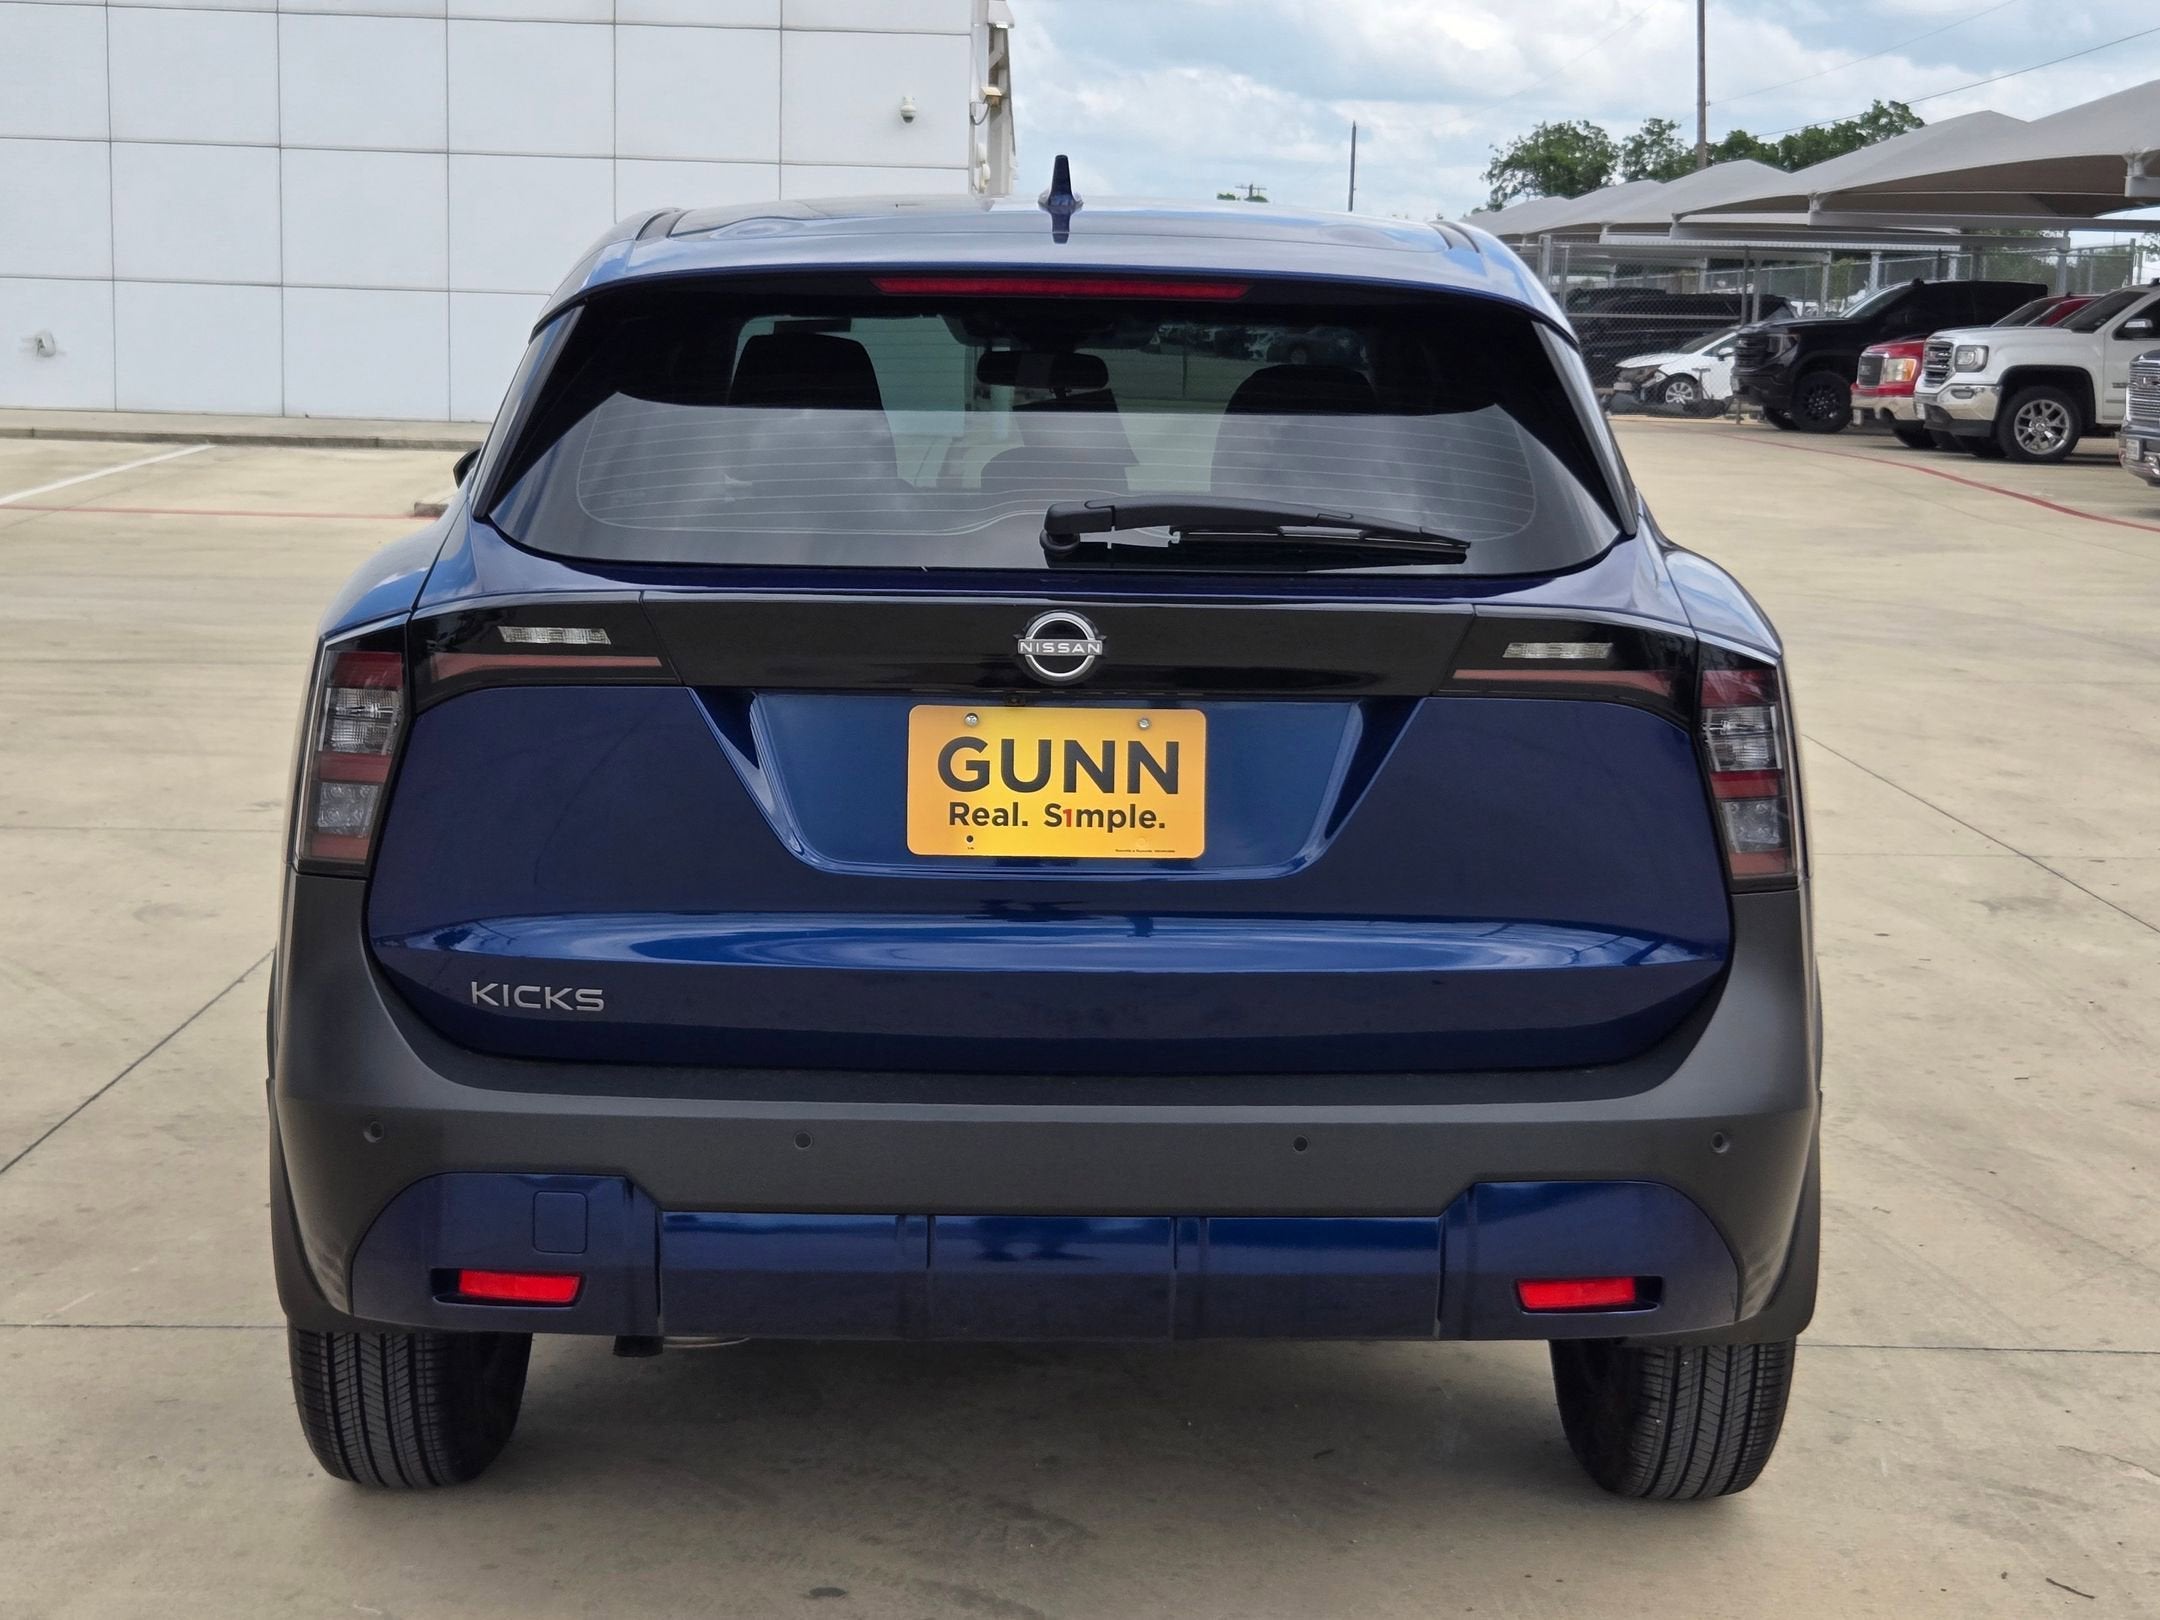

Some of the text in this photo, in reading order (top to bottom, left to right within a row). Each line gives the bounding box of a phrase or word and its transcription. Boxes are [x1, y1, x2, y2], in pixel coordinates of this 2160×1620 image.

[1020, 642, 1100, 653] NISSAN
[937, 736, 1179, 794] GUNN
[949, 802, 1028, 827] Real.
[471, 981, 605, 1012] KICKS
